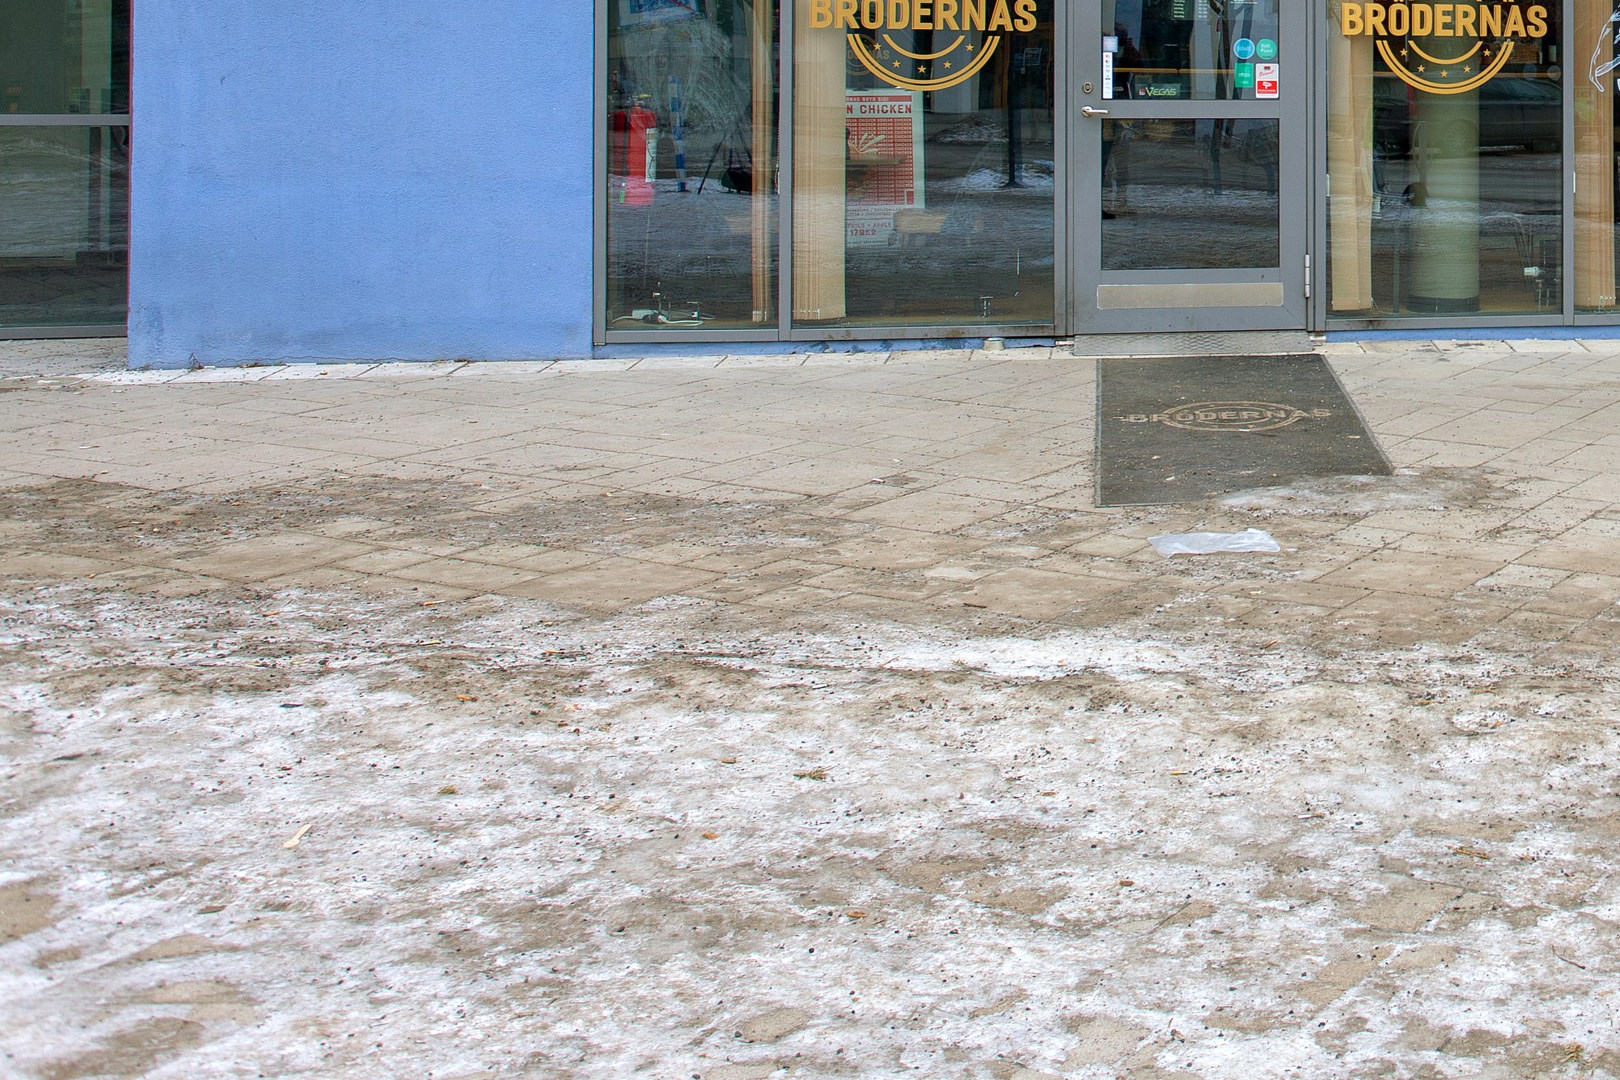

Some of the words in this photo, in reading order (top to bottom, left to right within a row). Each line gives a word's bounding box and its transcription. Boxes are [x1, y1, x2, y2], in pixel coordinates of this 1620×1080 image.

[1145, 86, 1177, 96] VEGAS
[860, 104, 912, 114] CHICKEN
[1125, 407, 1332, 424] BRÖDERNAS
